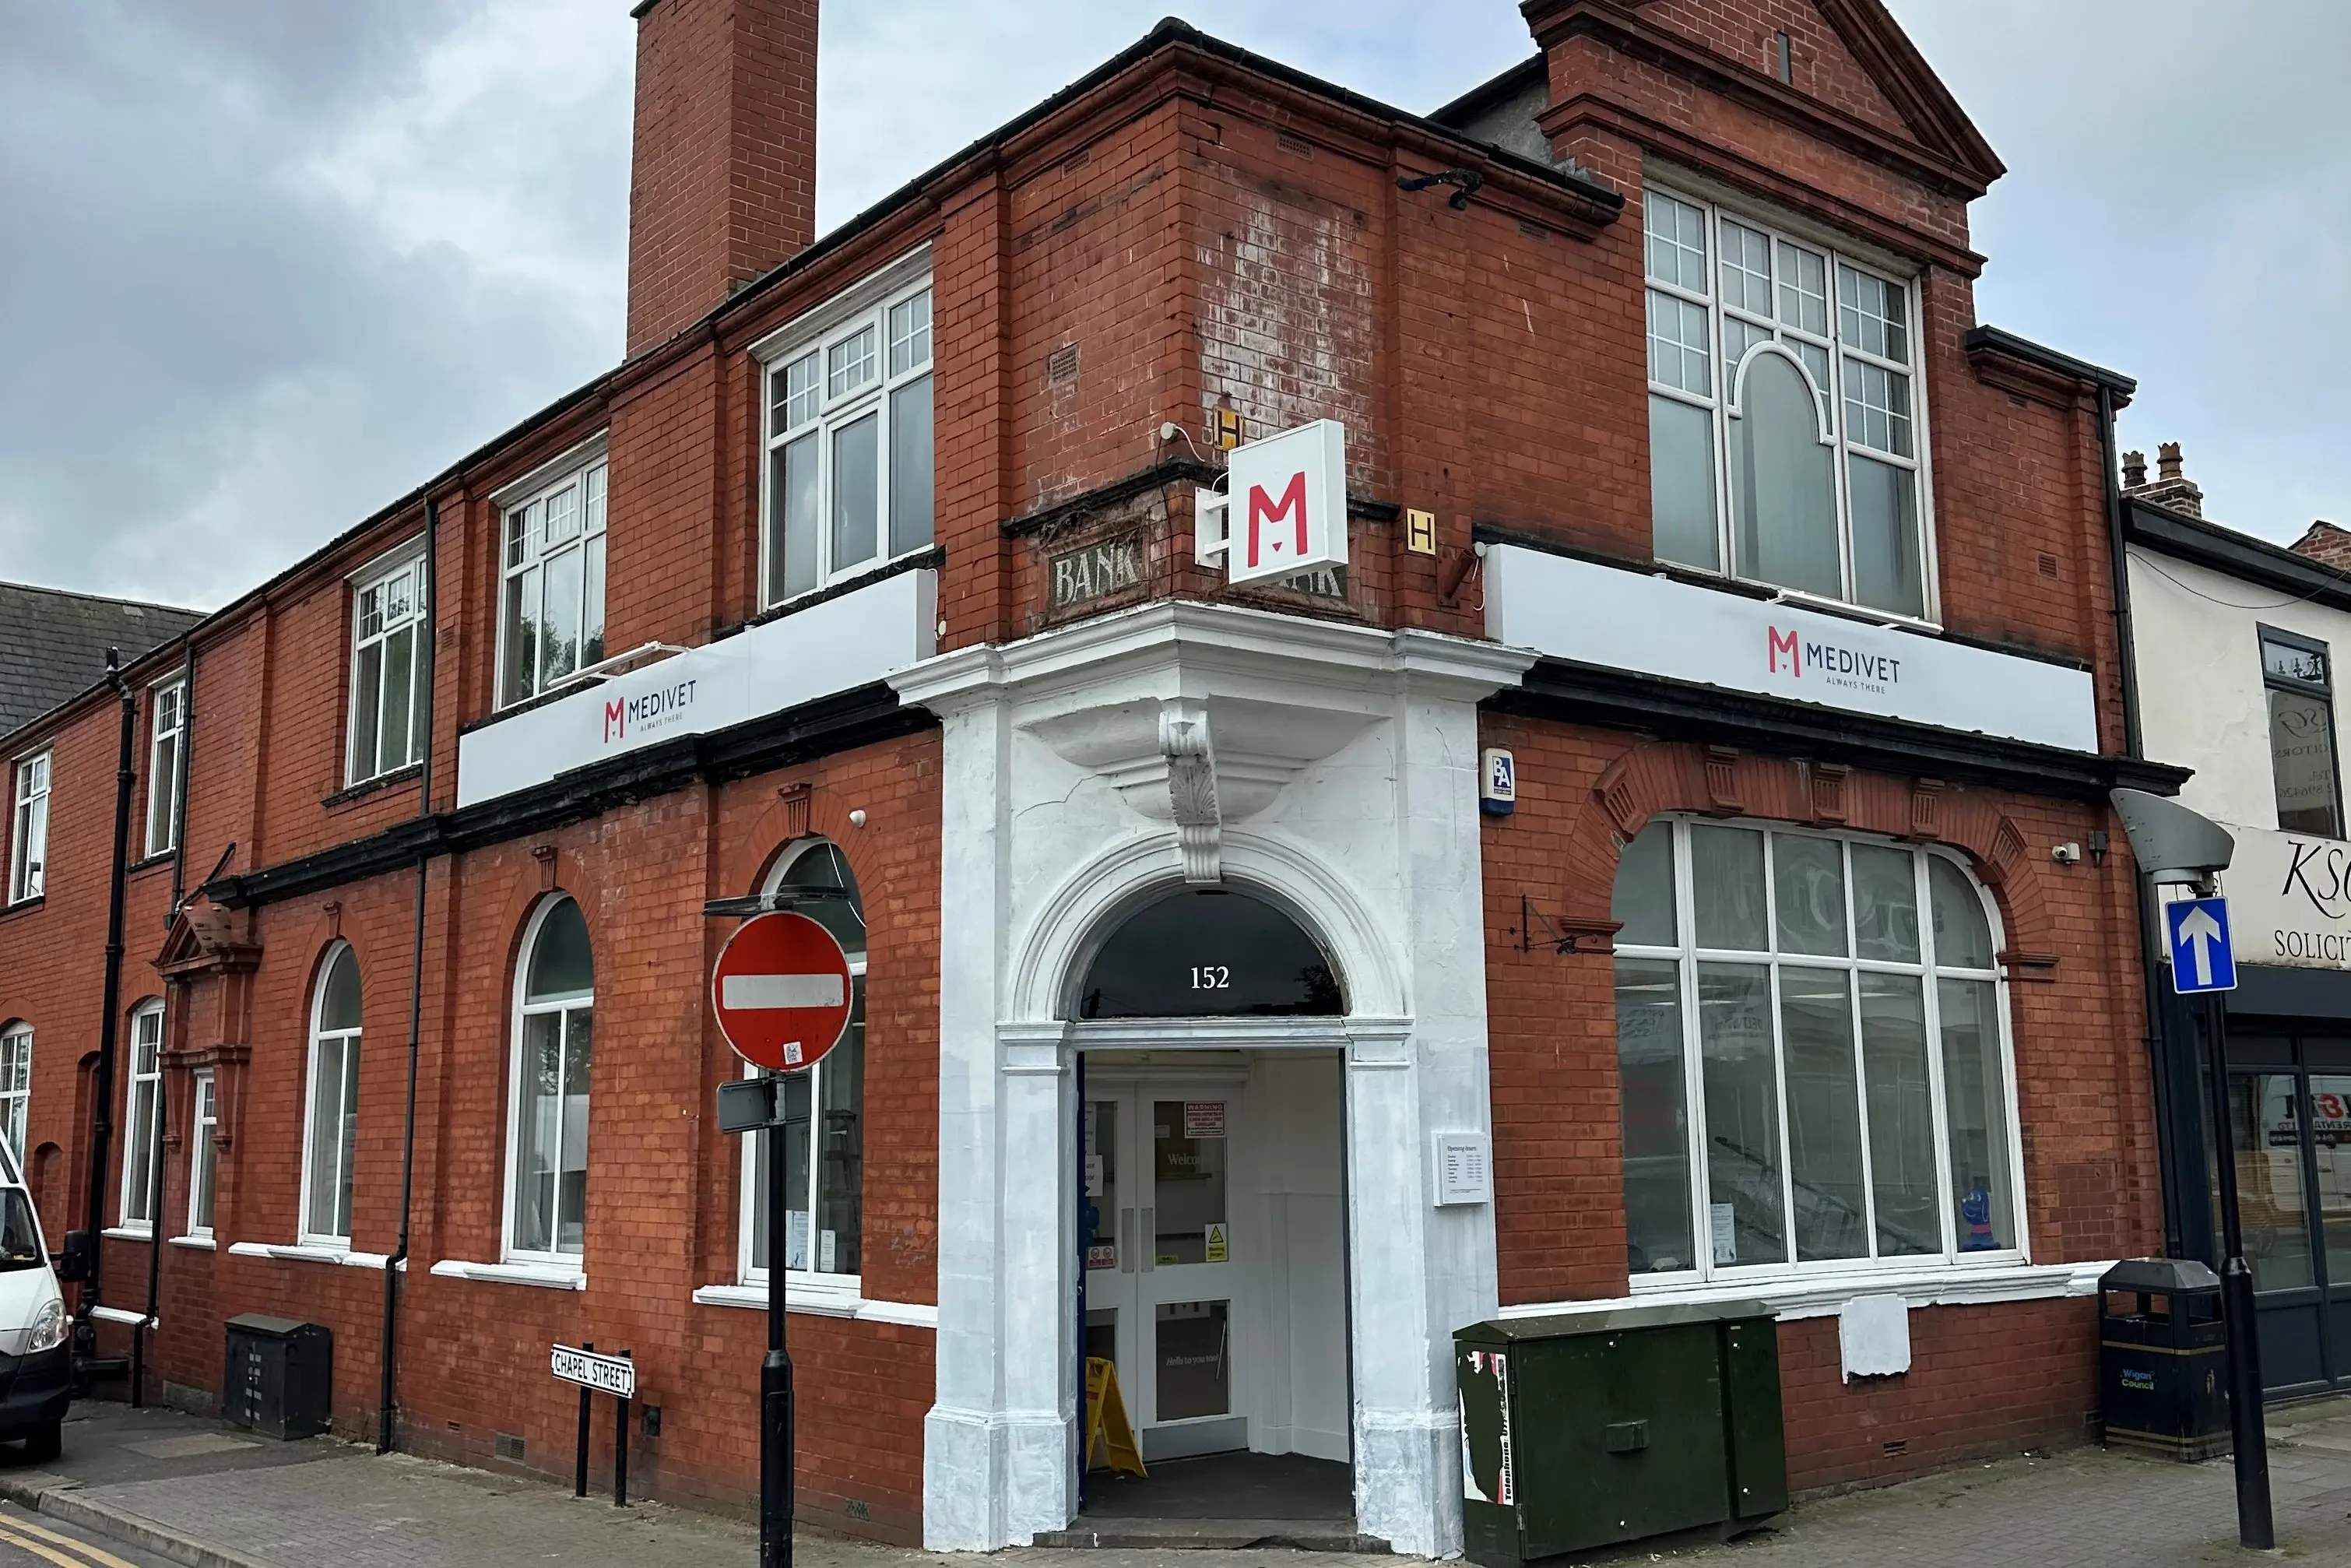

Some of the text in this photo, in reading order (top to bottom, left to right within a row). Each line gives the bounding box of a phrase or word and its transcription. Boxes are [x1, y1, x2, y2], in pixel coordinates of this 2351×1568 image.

[1218, 410, 1240, 447] H
[1248, 471, 1307, 568] M
[1411, 513, 1432, 550] H
[1055, 543, 1139, 606] BANK
[1768, 625, 1900, 683] M MEDIVET
[1826, 676, 1885, 694] ALWAYS THERE
[604, 679, 697, 744] M MEDIVET
[640, 712, 683, 732] ALWAYS THERE
[1190, 965, 1230, 990] 152
[1168, 1152, 1207, 1165] Welco
[554, 1353, 627, 1390] CHAPEL STREET
[2121, 1379, 2154, 1390] Council
[2123, 1369, 2152, 1380] Wigan
